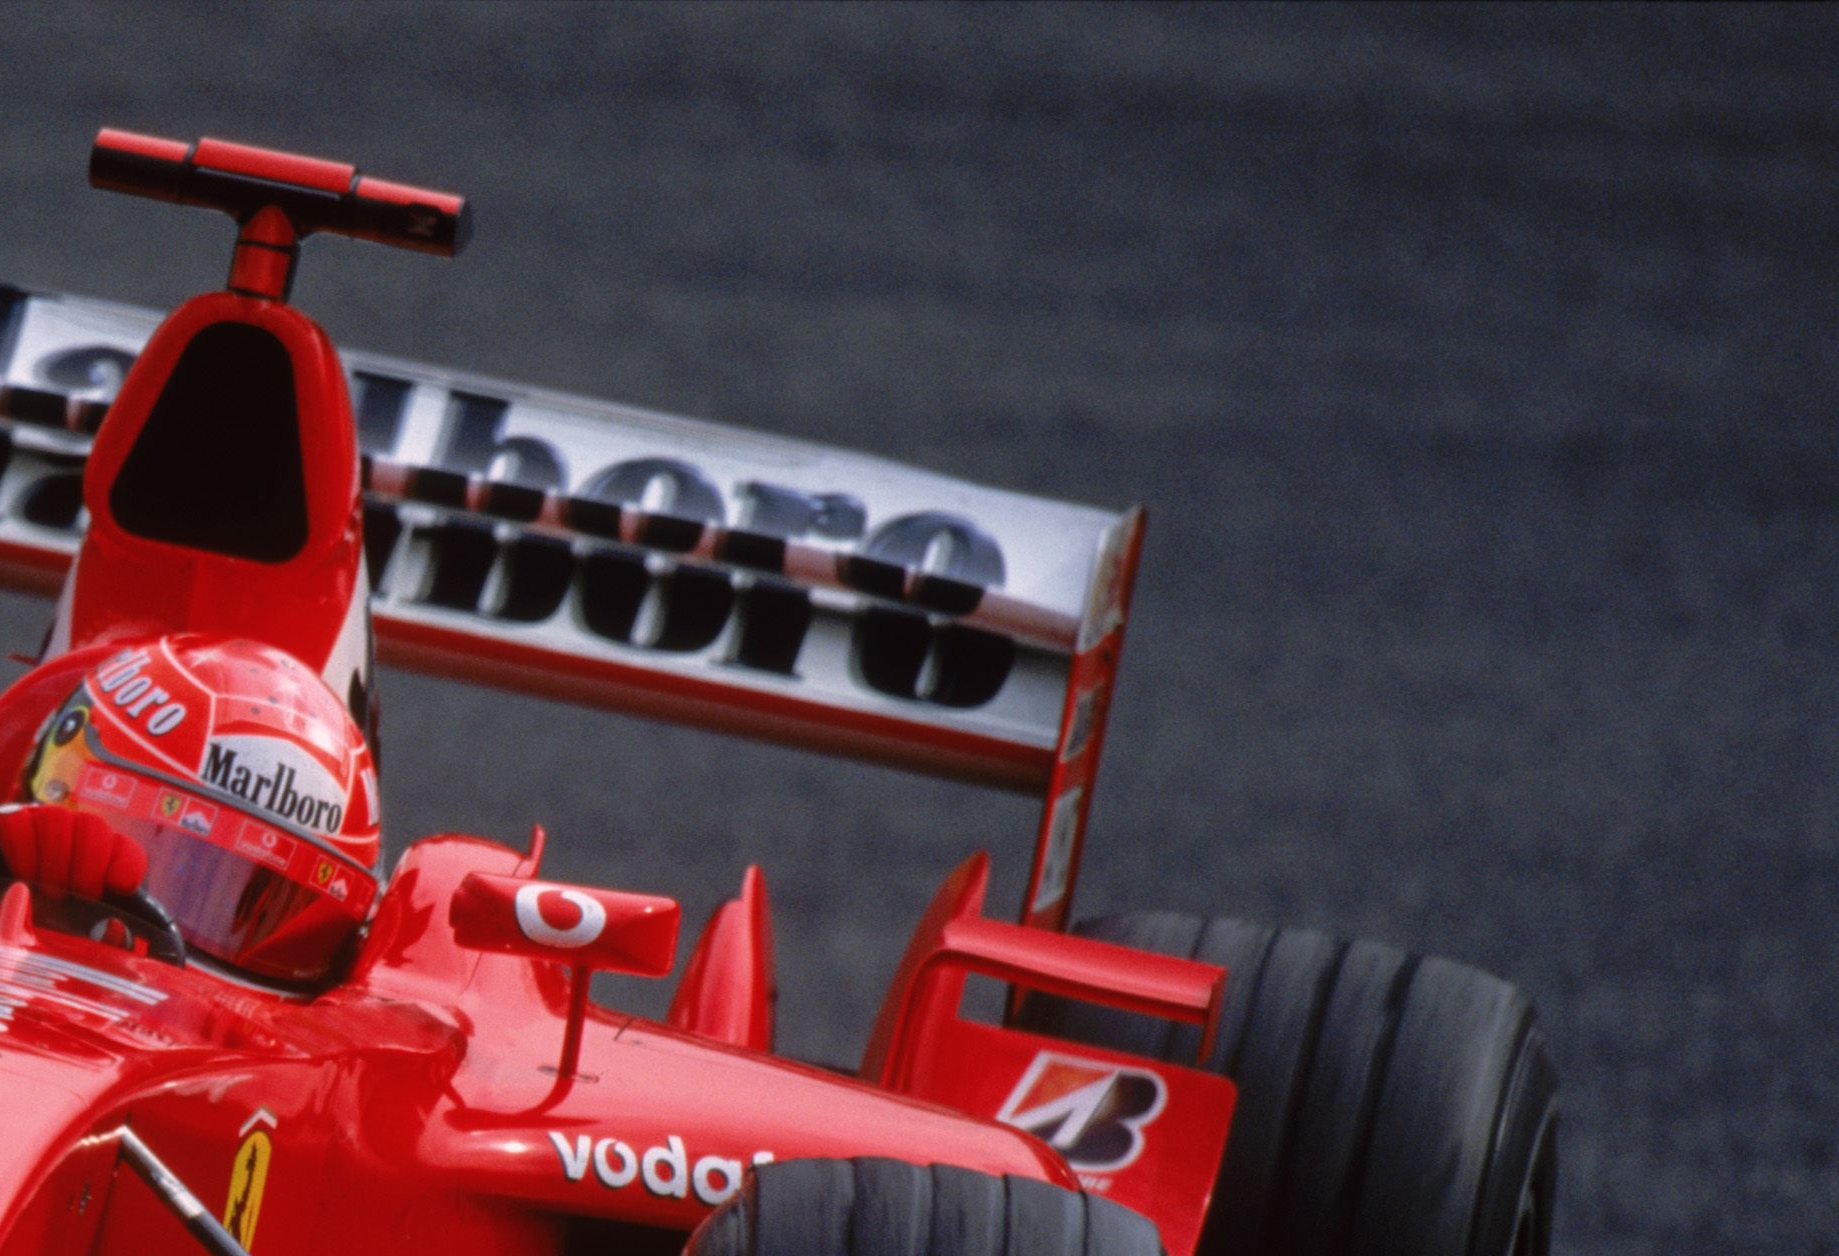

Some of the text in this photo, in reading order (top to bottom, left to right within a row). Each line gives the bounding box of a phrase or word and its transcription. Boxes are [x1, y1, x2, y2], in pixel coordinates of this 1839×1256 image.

[96, 647, 187, 736] lboro
[201, 743, 343, 834] Marlboro
[548, 1131, 774, 1206] voda
